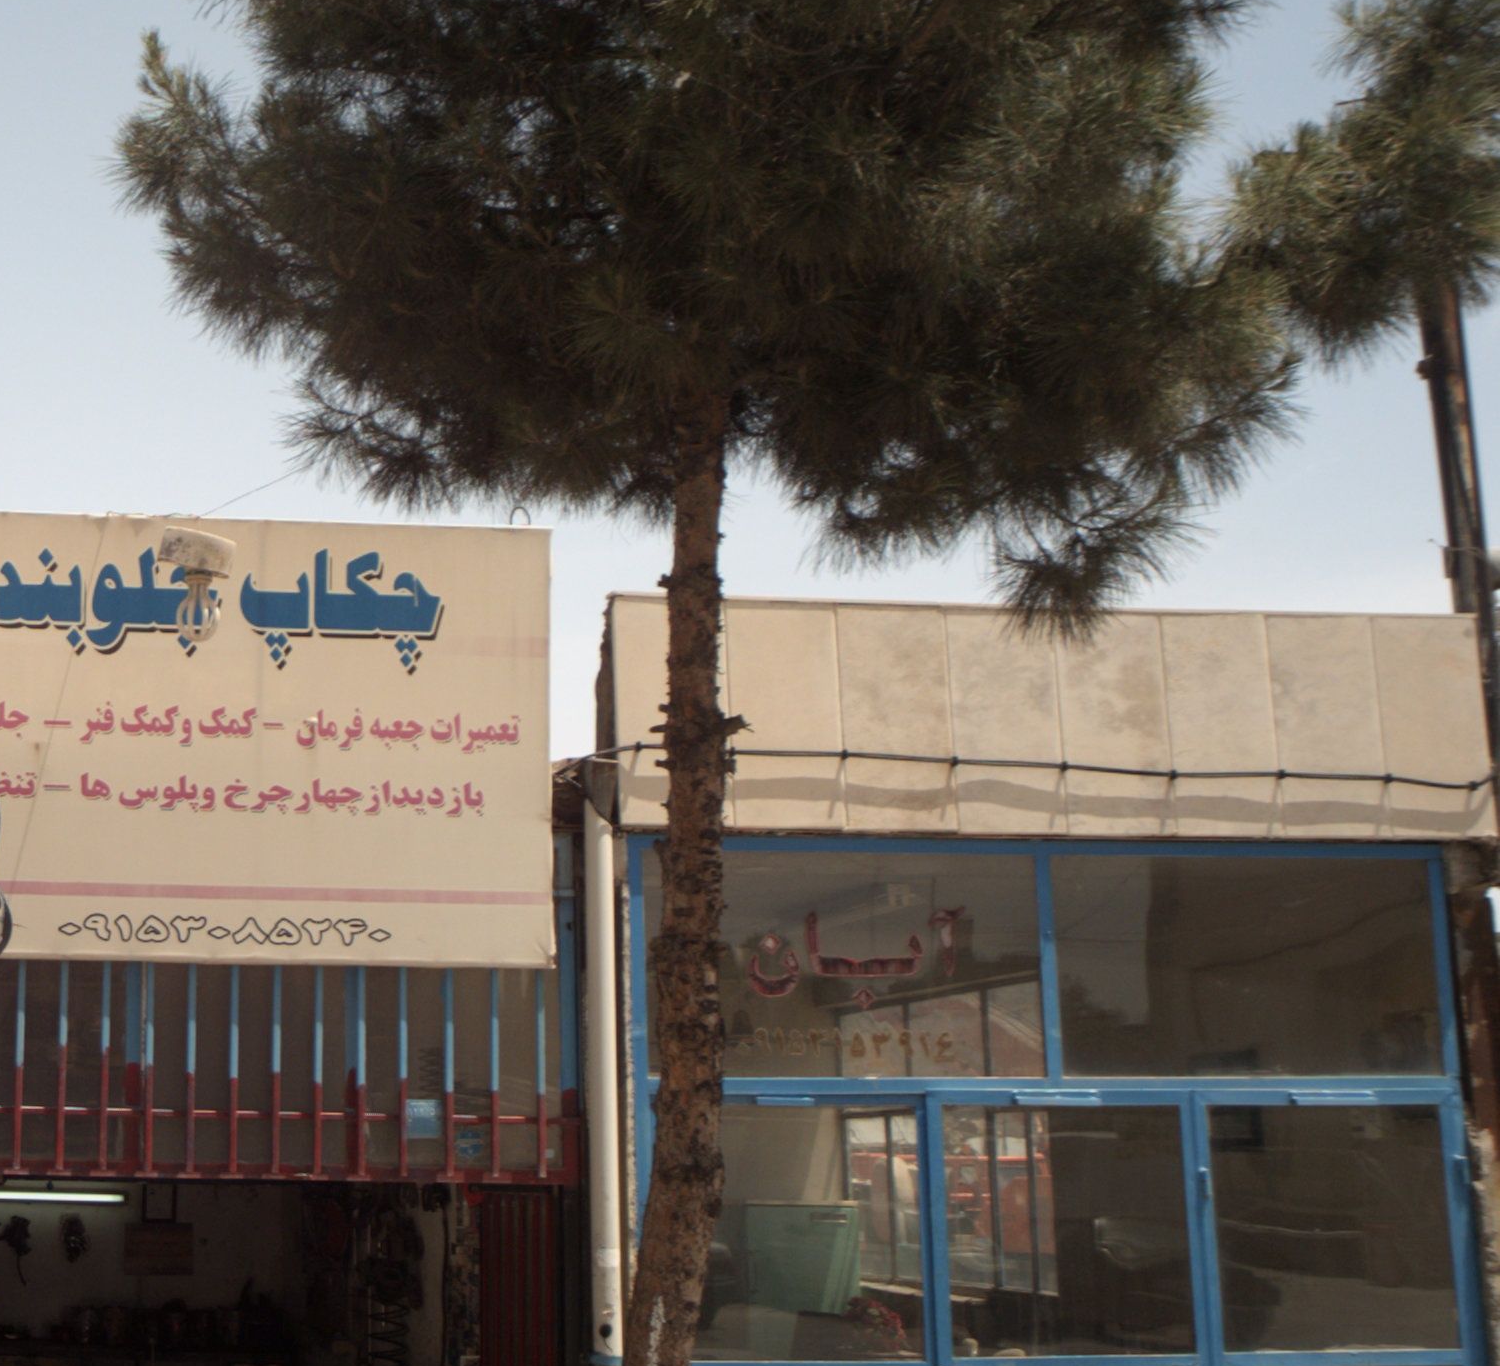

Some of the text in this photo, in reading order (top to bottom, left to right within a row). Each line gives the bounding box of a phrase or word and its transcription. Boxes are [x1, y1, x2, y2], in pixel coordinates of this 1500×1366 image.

[240, 547, 444, 675] چکاپ
[80, 700, 115, 743] فنر
[200, 707, 258, 738] کمک
[296, 708, 364, 749] فرمان
[369, 716, 424, 751] جعبه
[430, 714, 521, 753] تعمیرات
